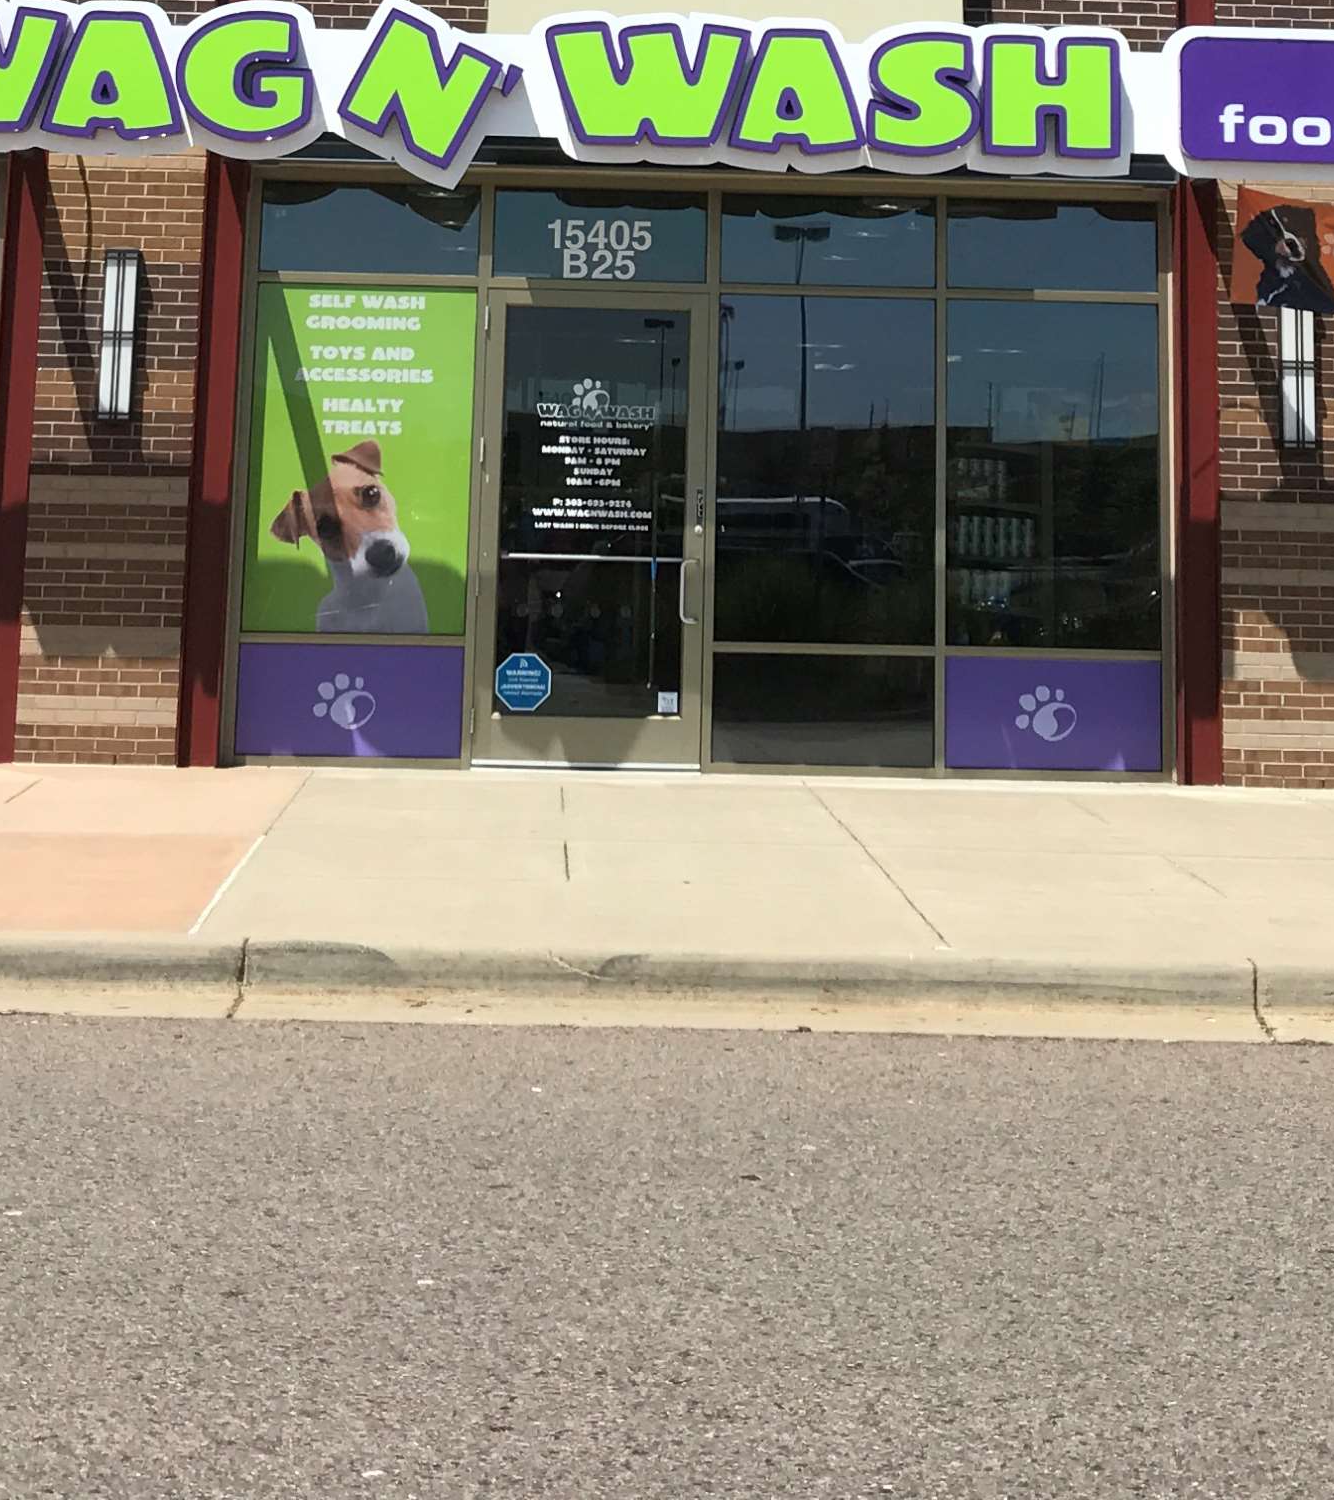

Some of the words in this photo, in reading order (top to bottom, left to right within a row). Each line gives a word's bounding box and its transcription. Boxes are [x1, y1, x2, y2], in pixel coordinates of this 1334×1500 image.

[545, 20, 1121, 159] WASH
[548, 219, 652, 252] 15405
[562, 248, 636, 280] B25
[309, 294, 356, 309] SELF
[361, 295, 426, 310] WASH
[306, 315, 422, 331] GROOMING
[310, 345, 366, 360] TOYS
[371, 347, 416, 361] AND
[295, 366, 434, 384] ACCESSORIES
[322, 397, 404, 413] HEALTY
[537, 403, 581, 419] WAG
[601, 405, 656, 421] WASH
[322, 419, 403, 436] TREATS
[540, 420, 578, 429] natural
[580, 420, 604, 429] food
[559, 435, 591, 444] STORE
[593, 436, 631, 446] HOURS:
[541, 445, 585, 454] MONDAY
[593, 447, 647, 456] SATURDAY
[573, 467, 613, 476] SUNDAY
